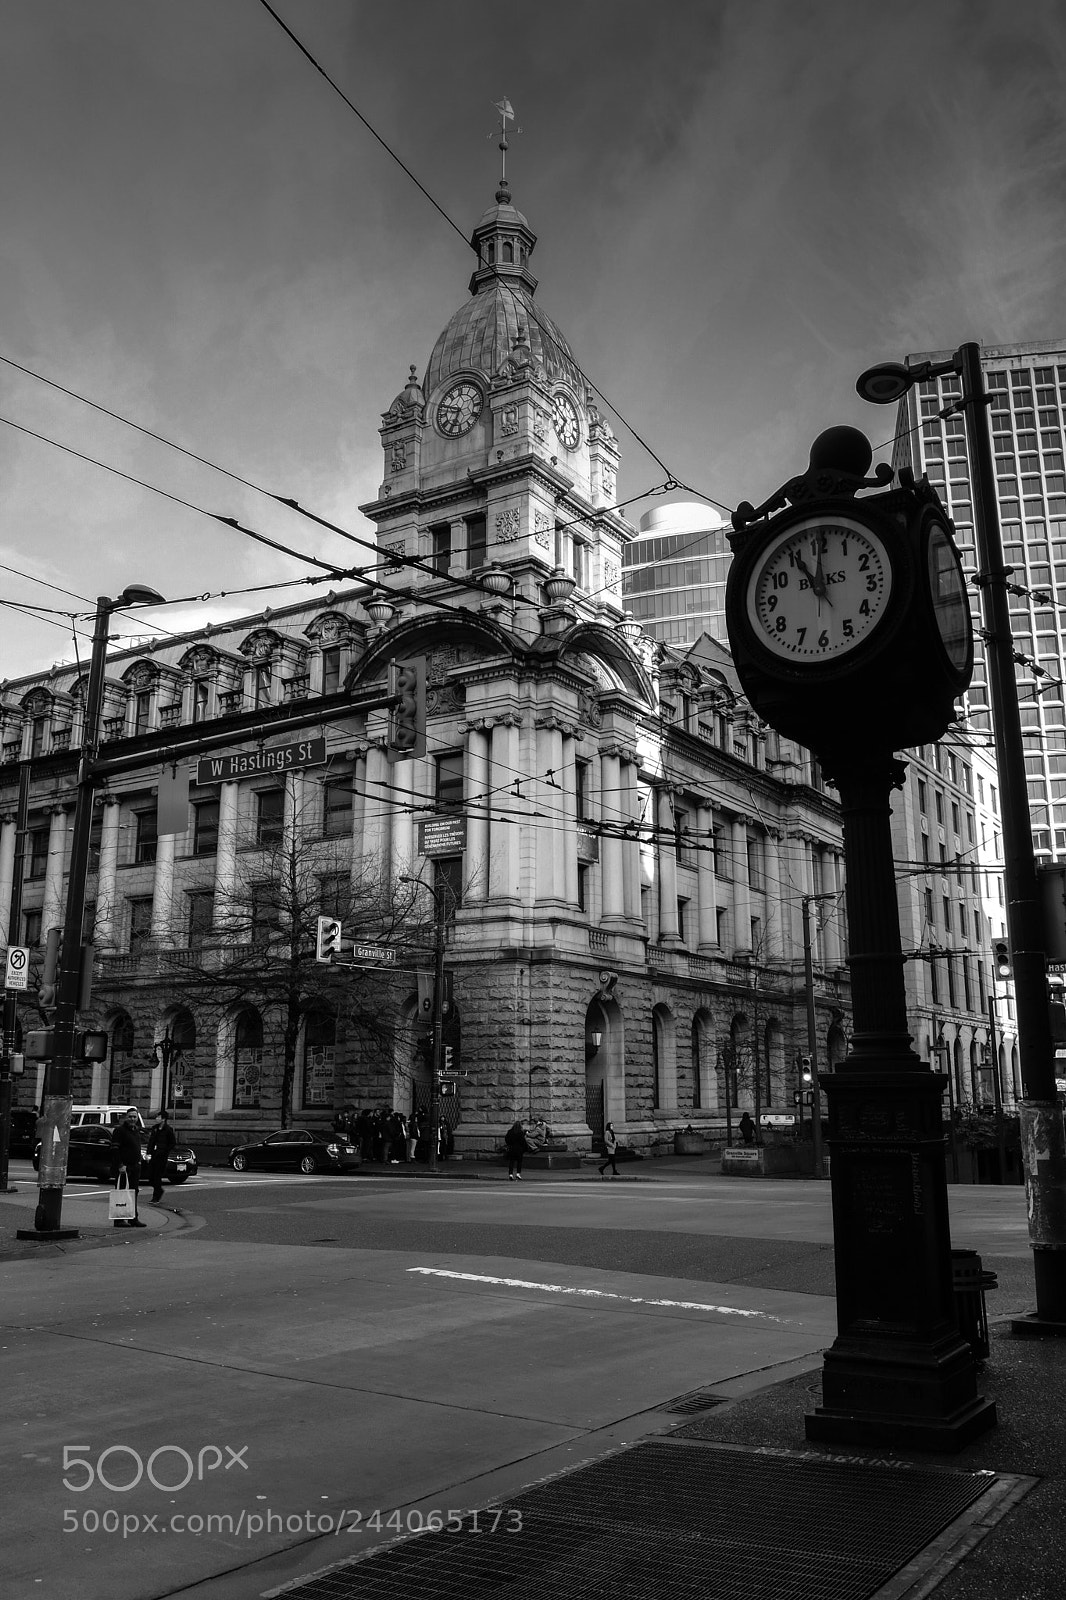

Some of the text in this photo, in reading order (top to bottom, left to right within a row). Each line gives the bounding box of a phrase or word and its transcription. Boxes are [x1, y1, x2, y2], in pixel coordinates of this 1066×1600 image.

[841, 539, 847, 556] 1
[858, 553, 870, 572] 2
[772, 571, 789, 590] 10
[799, 570, 846, 591] BKS
[866, 574, 877, 592] 3
[767, 595, 778, 612] 9
[859, 599, 870, 616] 4
[776, 615, 787, 632] 8
[842, 619, 853, 637] 5
[797, 627, 808, 646] 7
[818, 630, 829, 647] 6
[211, 742, 312, 777] W Hastings St
[358, 947, 392, 960] Granville St
